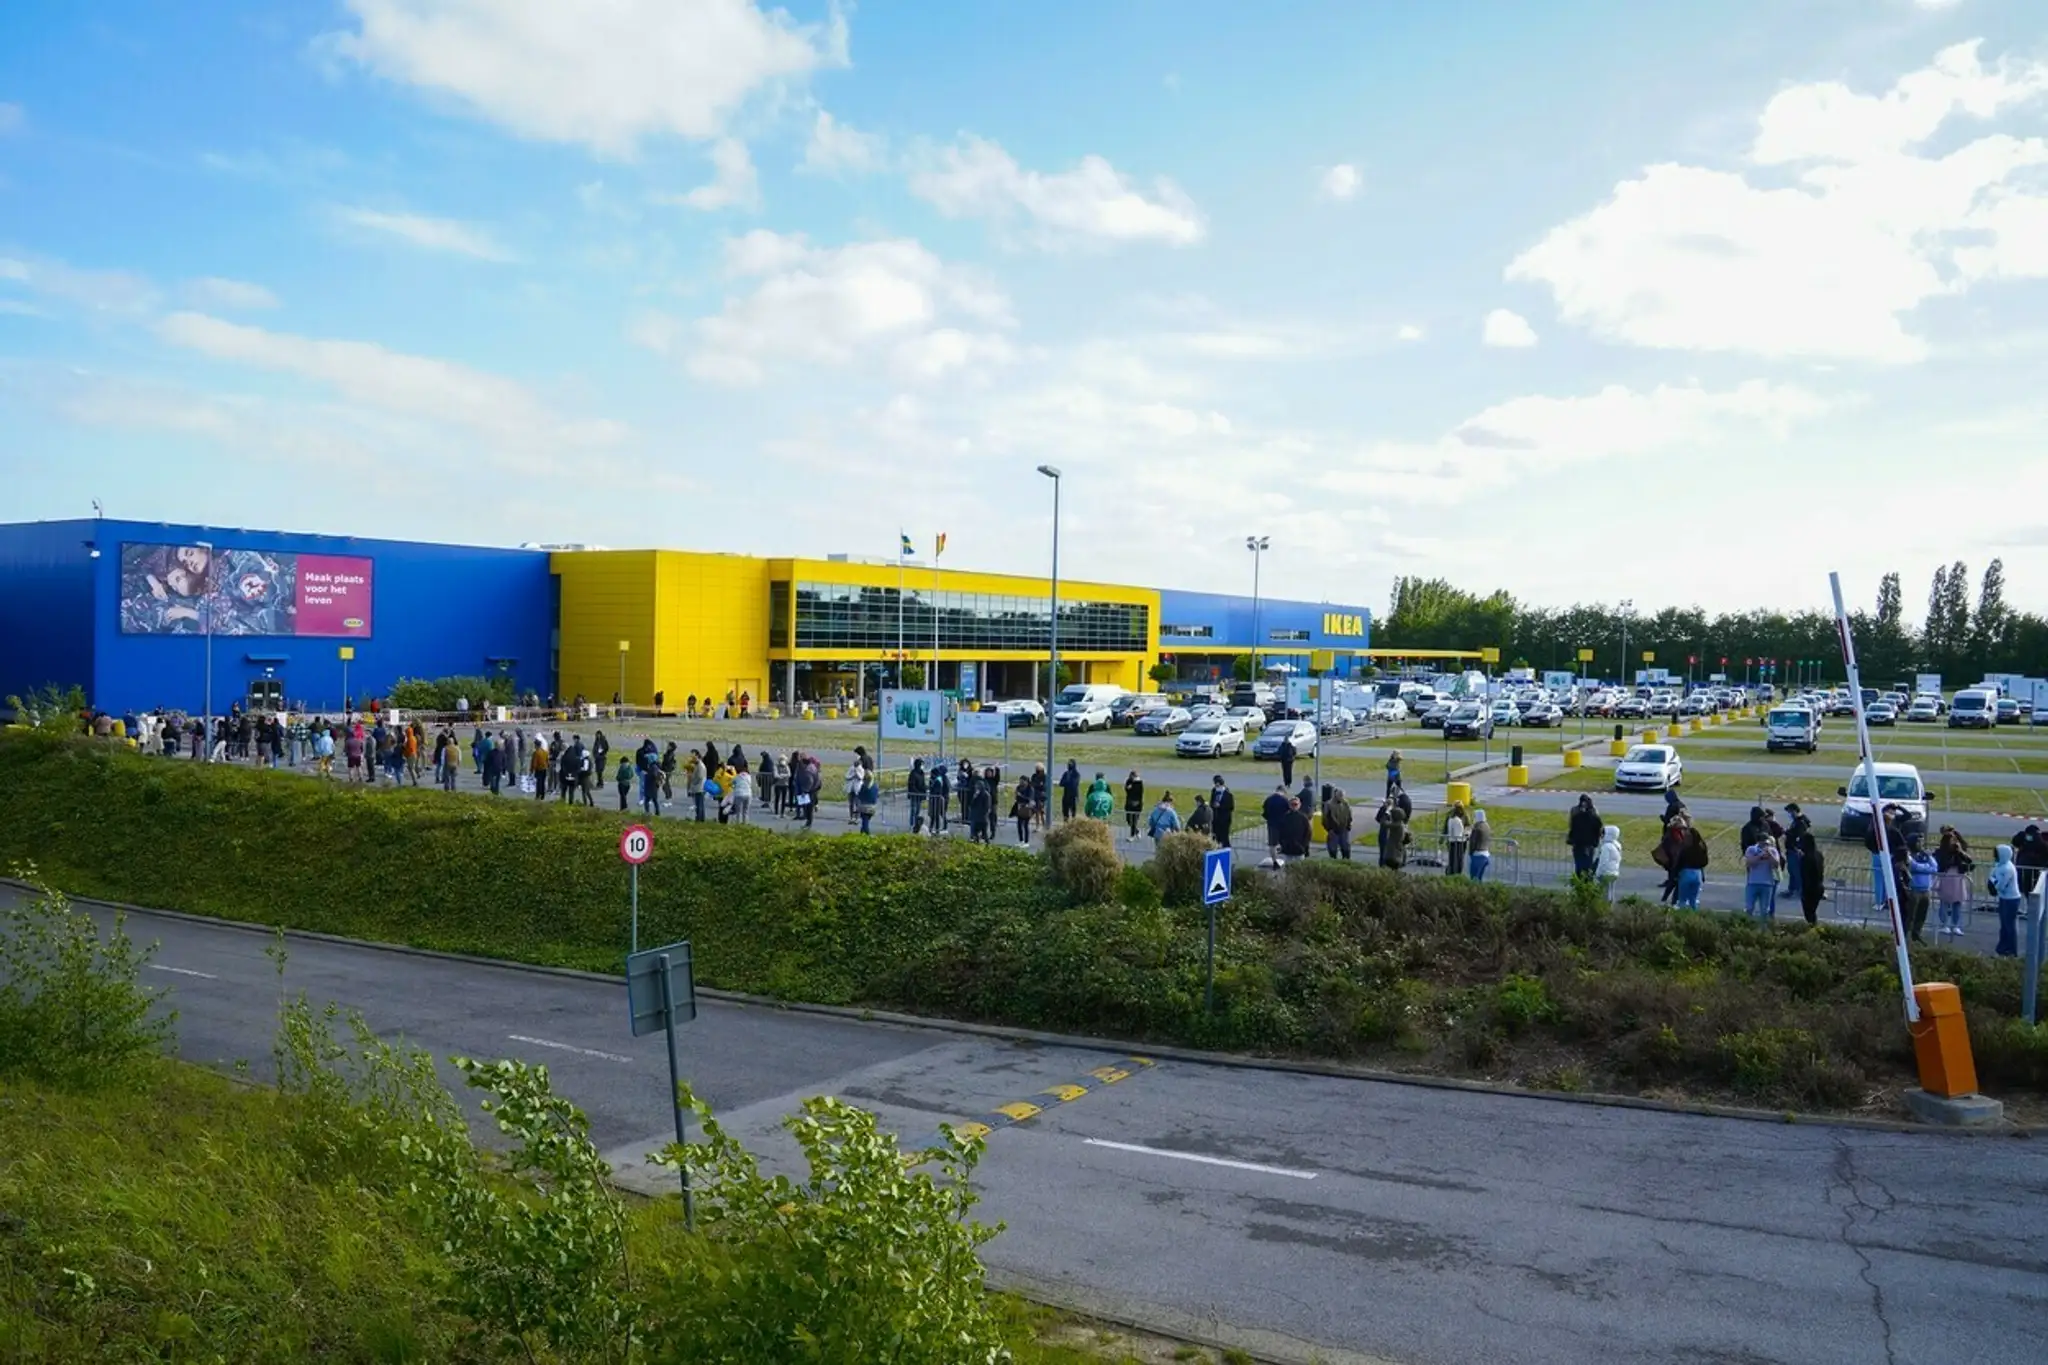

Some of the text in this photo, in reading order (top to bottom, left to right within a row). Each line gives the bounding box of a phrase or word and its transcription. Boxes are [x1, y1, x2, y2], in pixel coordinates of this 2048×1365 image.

[305, 572, 364, 584] Maak plaats
[305, 585, 347, 594] voor het
[305, 595, 332, 604] leven
[1323, 613, 1363, 636] IKEA
[630, 838, 645, 852] 10
